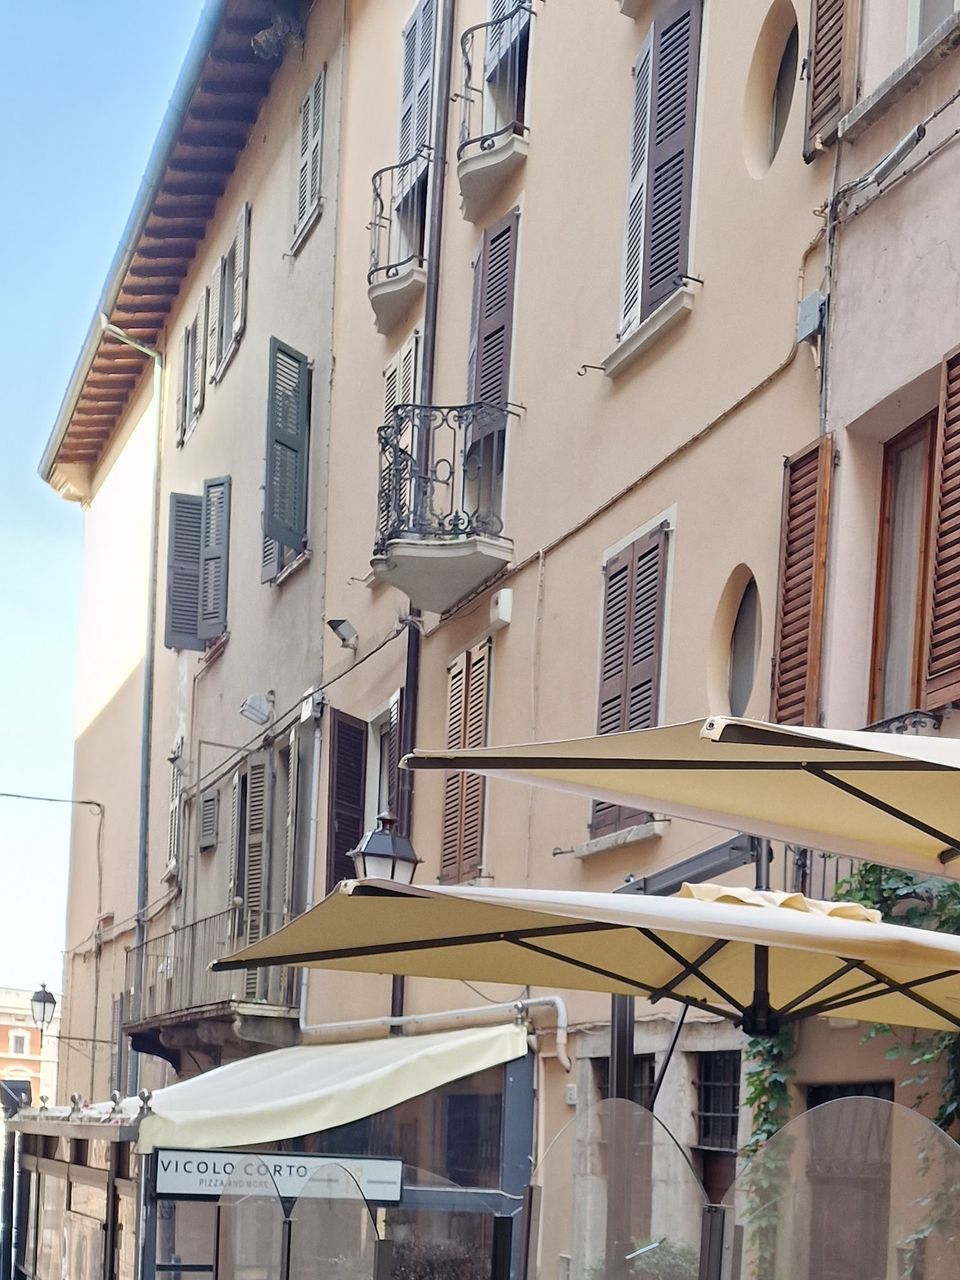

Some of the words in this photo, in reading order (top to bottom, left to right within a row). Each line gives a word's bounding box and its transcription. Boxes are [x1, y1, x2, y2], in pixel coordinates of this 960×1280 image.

[160, 1159, 235, 1175] VICOLO
[243, 1162, 308, 1178] CORTO
[199, 1178, 225, 1188] PIZZA
[227, 1179, 244, 1188] AND
